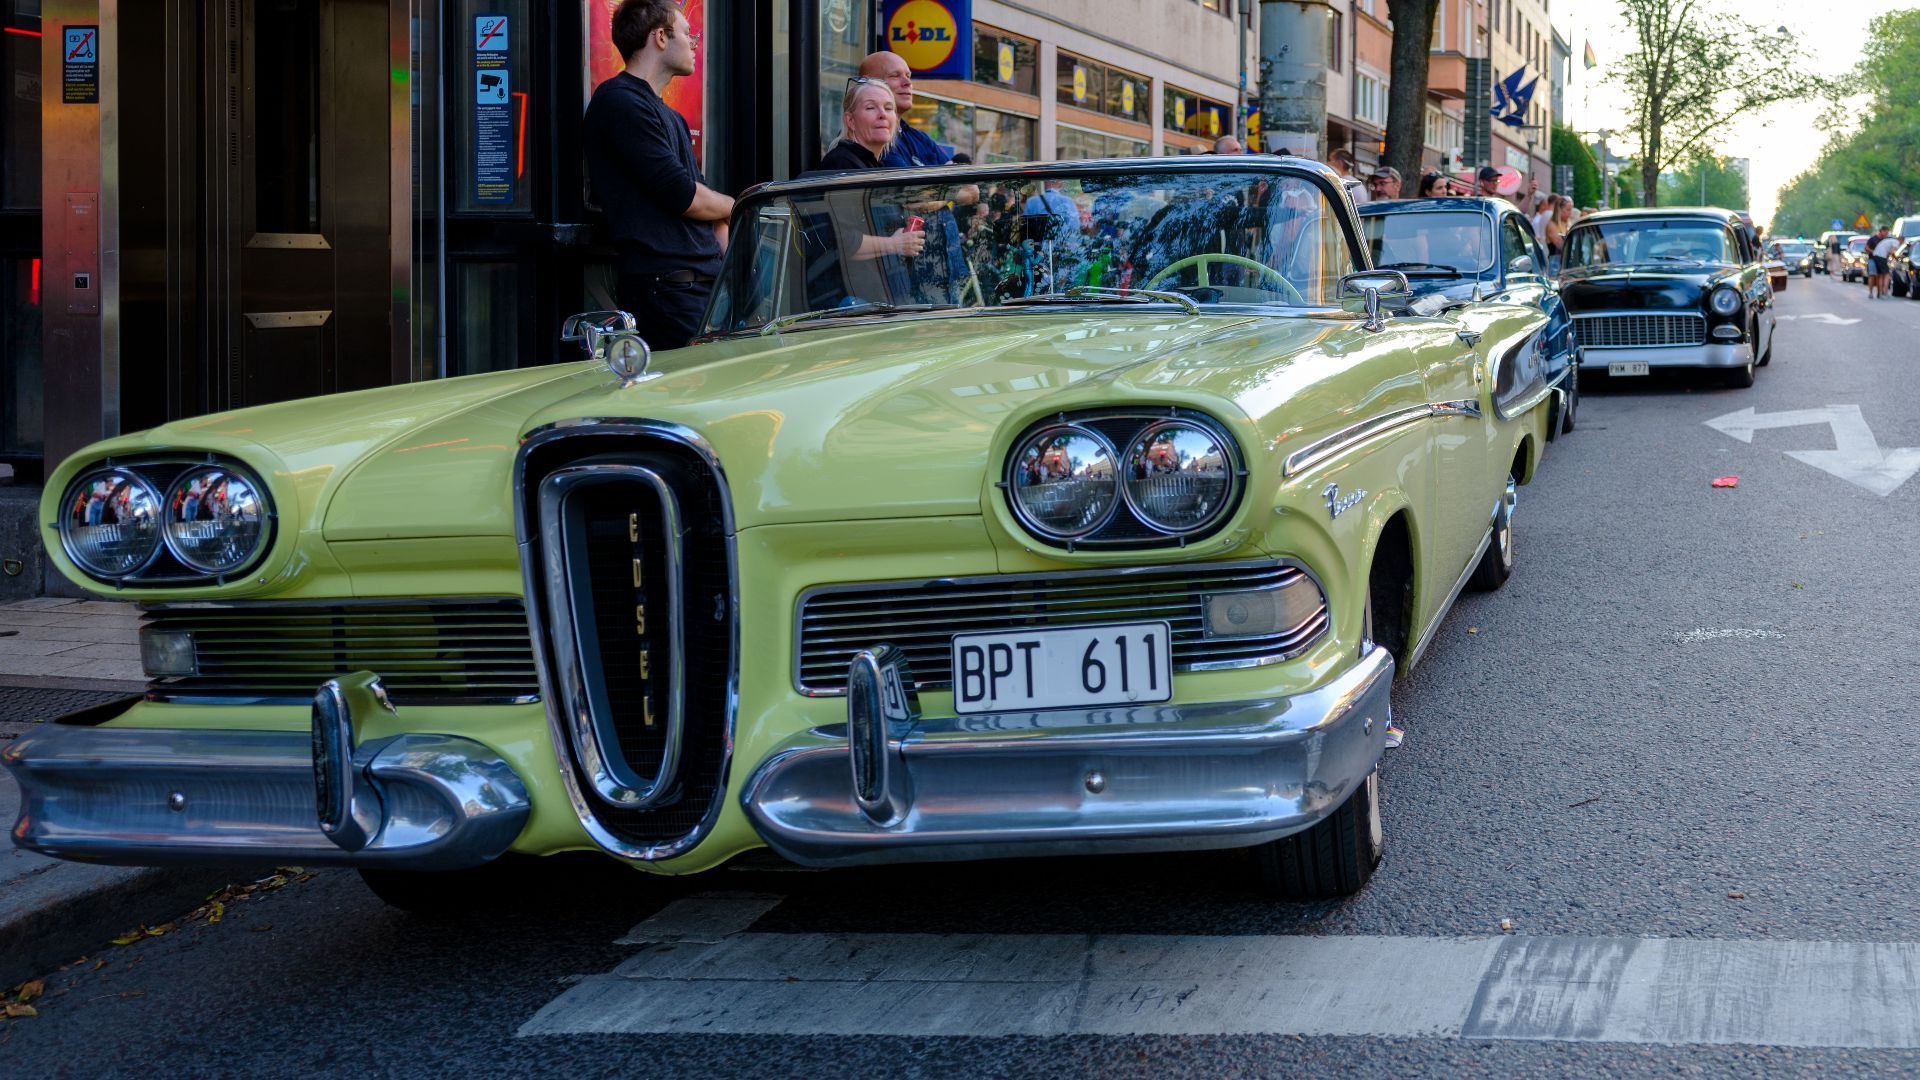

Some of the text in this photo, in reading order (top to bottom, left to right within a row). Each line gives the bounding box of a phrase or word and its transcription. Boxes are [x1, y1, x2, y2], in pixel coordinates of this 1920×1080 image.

[629, 513, 654, 726] EDSEL
[960, 633, 1157, 702] BPT 611
